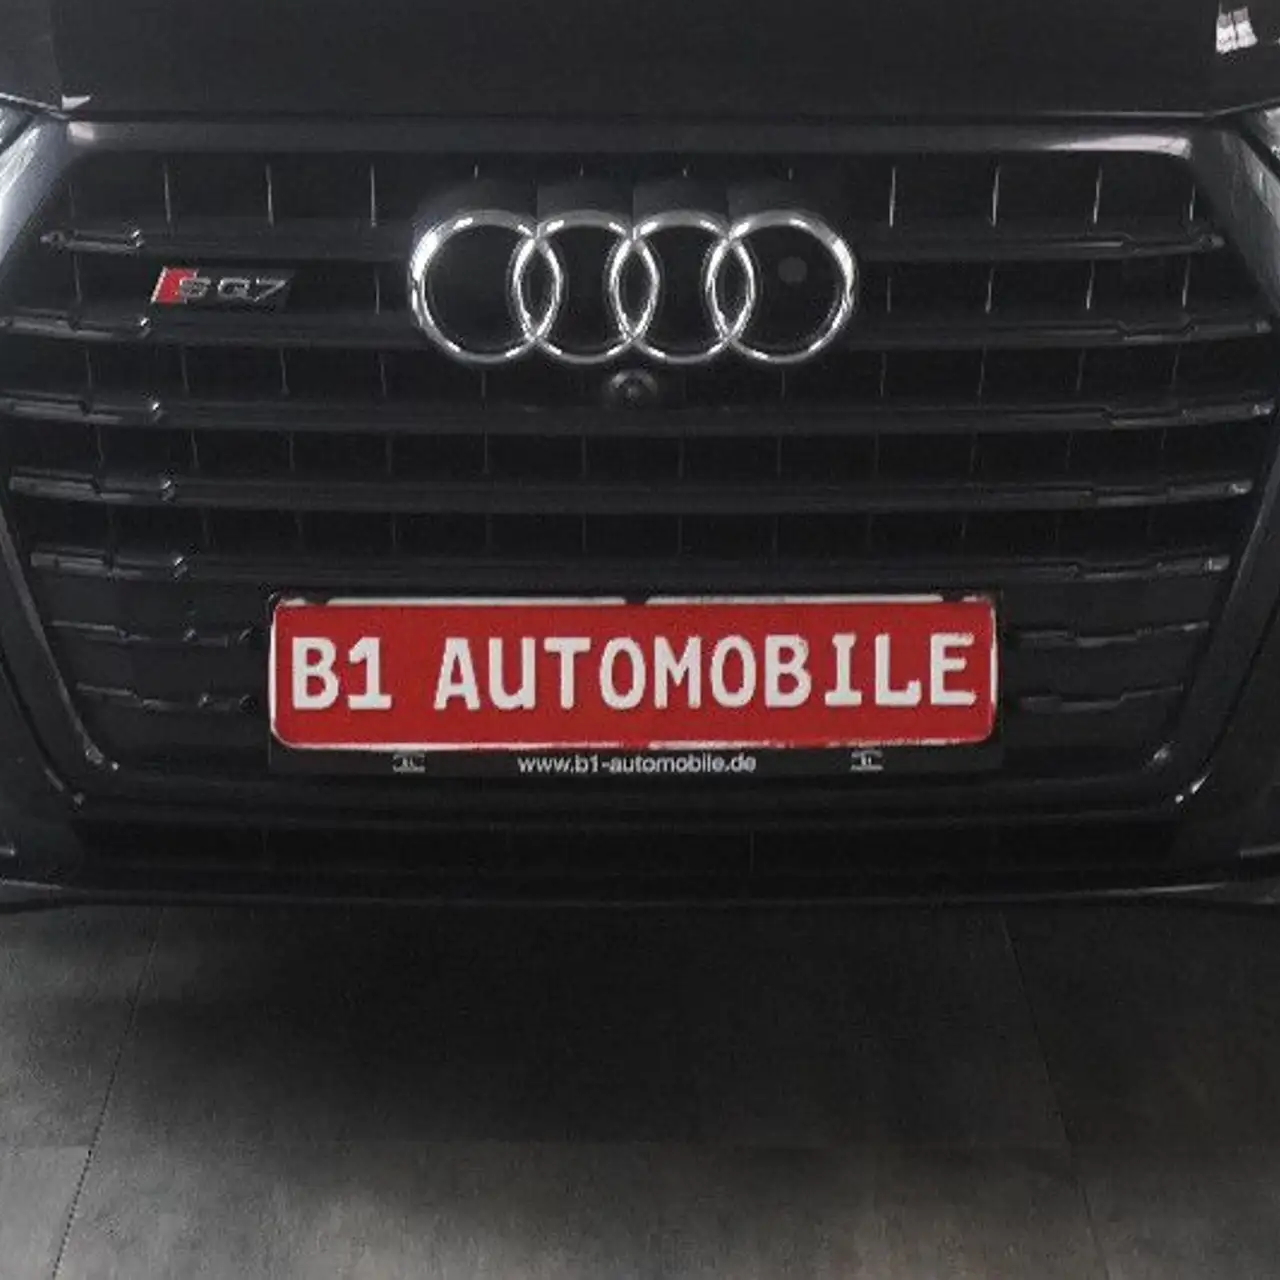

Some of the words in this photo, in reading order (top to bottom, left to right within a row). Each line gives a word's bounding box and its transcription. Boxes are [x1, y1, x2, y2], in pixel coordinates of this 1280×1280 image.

[179, 276, 287, 302] SQ7
[292, 636, 393, 710] B1
[433, 633, 977, 710] AUTOMOBILE
[517, 753, 757, 774] www.b1-automobile.de
